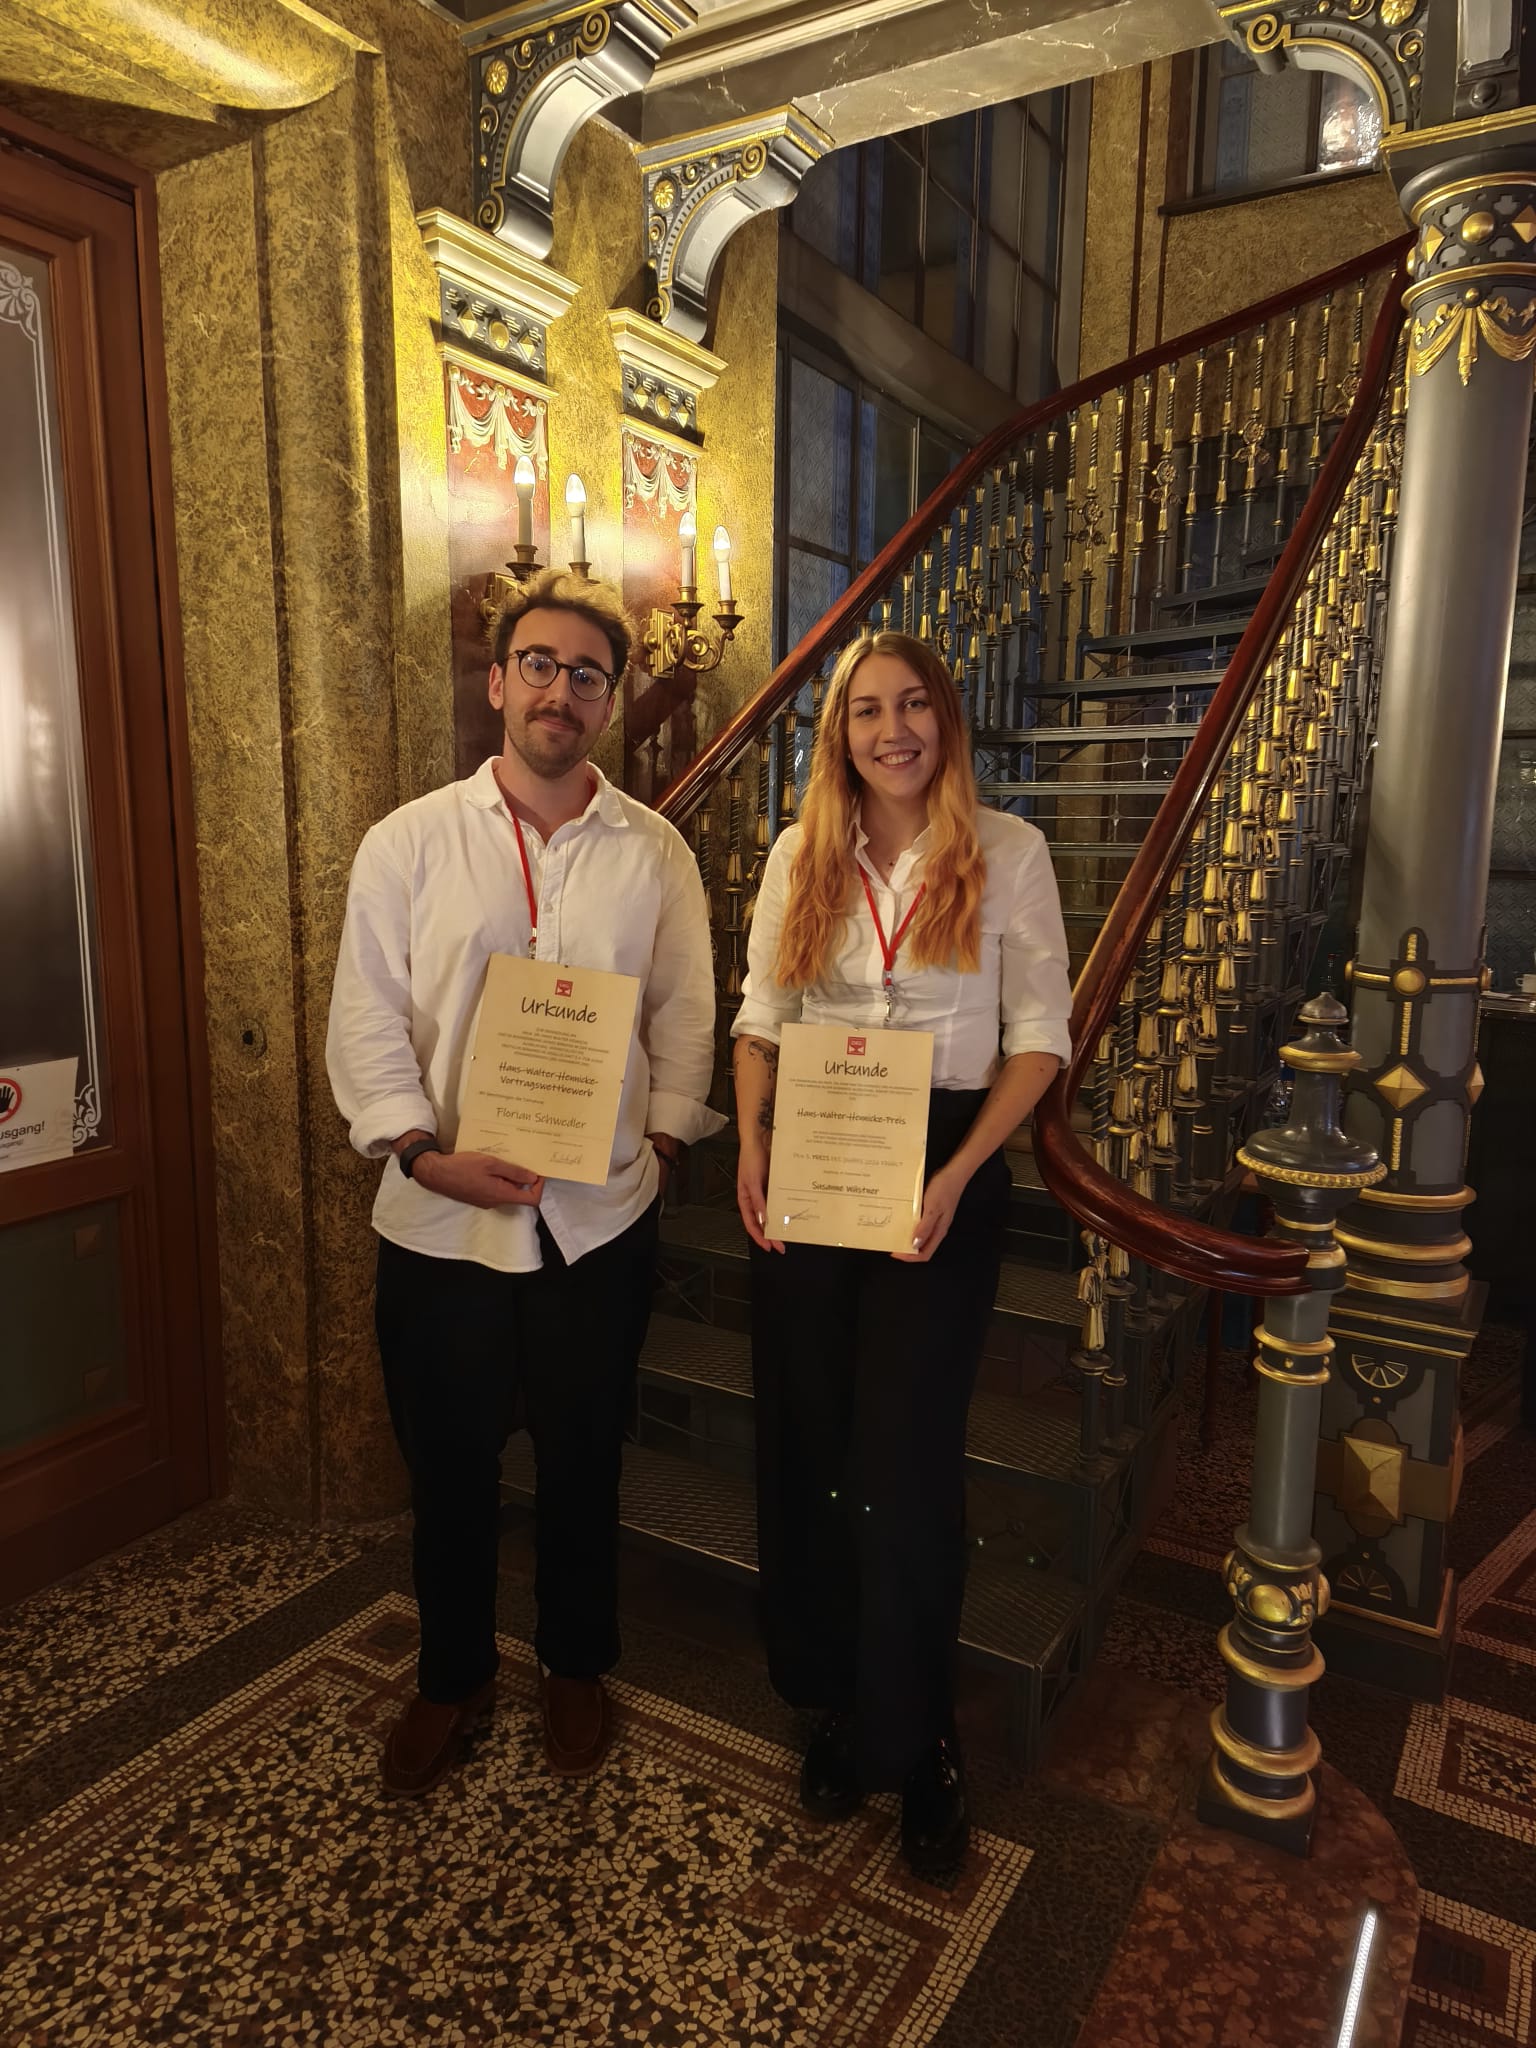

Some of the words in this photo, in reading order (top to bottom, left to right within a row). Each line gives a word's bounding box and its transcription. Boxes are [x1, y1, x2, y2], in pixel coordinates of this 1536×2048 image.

[521, 996, 598, 1024] Urkunde
[824, 1060, 888, 1078] Urkunde
[500, 1075, 594, 1097] Vortragswettbewerb
[496, 1107, 532, 1121] Florian
